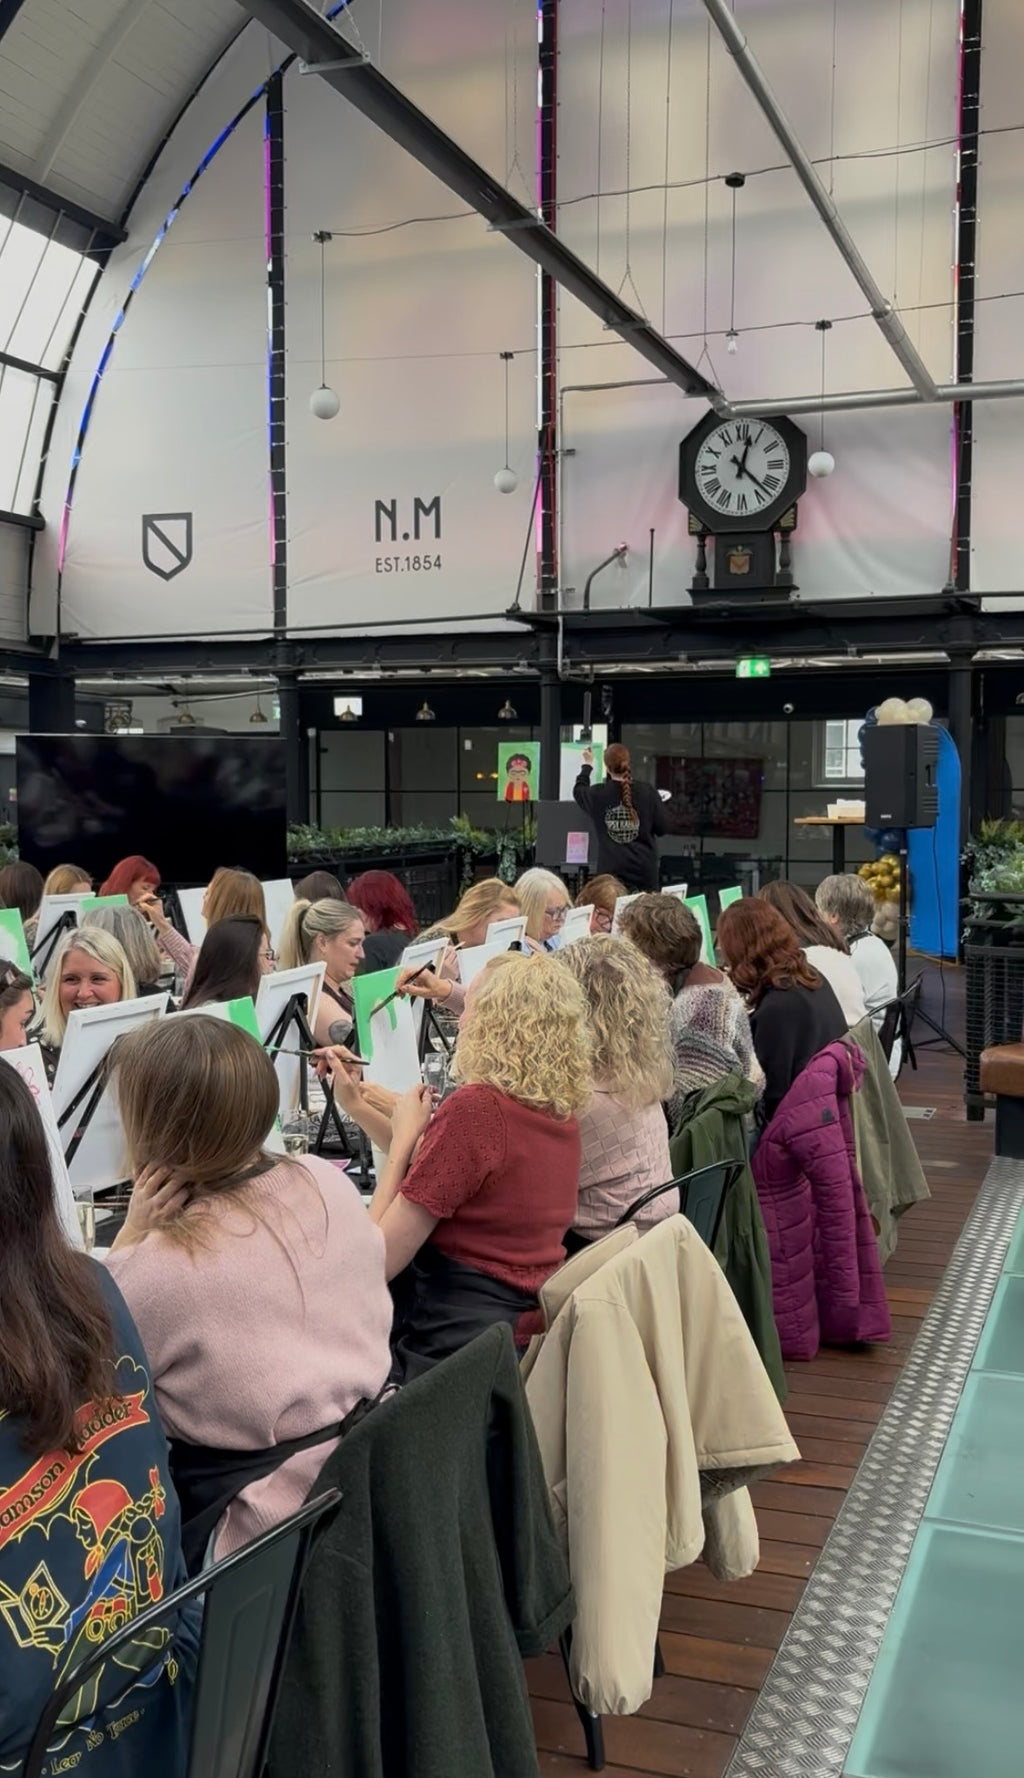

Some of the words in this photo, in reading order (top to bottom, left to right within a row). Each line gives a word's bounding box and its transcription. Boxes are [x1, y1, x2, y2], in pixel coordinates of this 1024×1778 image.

[718, 429, 733, 448] XI
[736, 424, 749, 441] XII
[705, 446, 721, 459] X
[763, 440, 780, 454] II
[767, 460, 784, 470] III
[754, 488, 766, 504] V
[375, 496, 441, 542] N.M
[375, 554, 442, 573] EST.1854
[0, 1462, 65, 1527] amson
